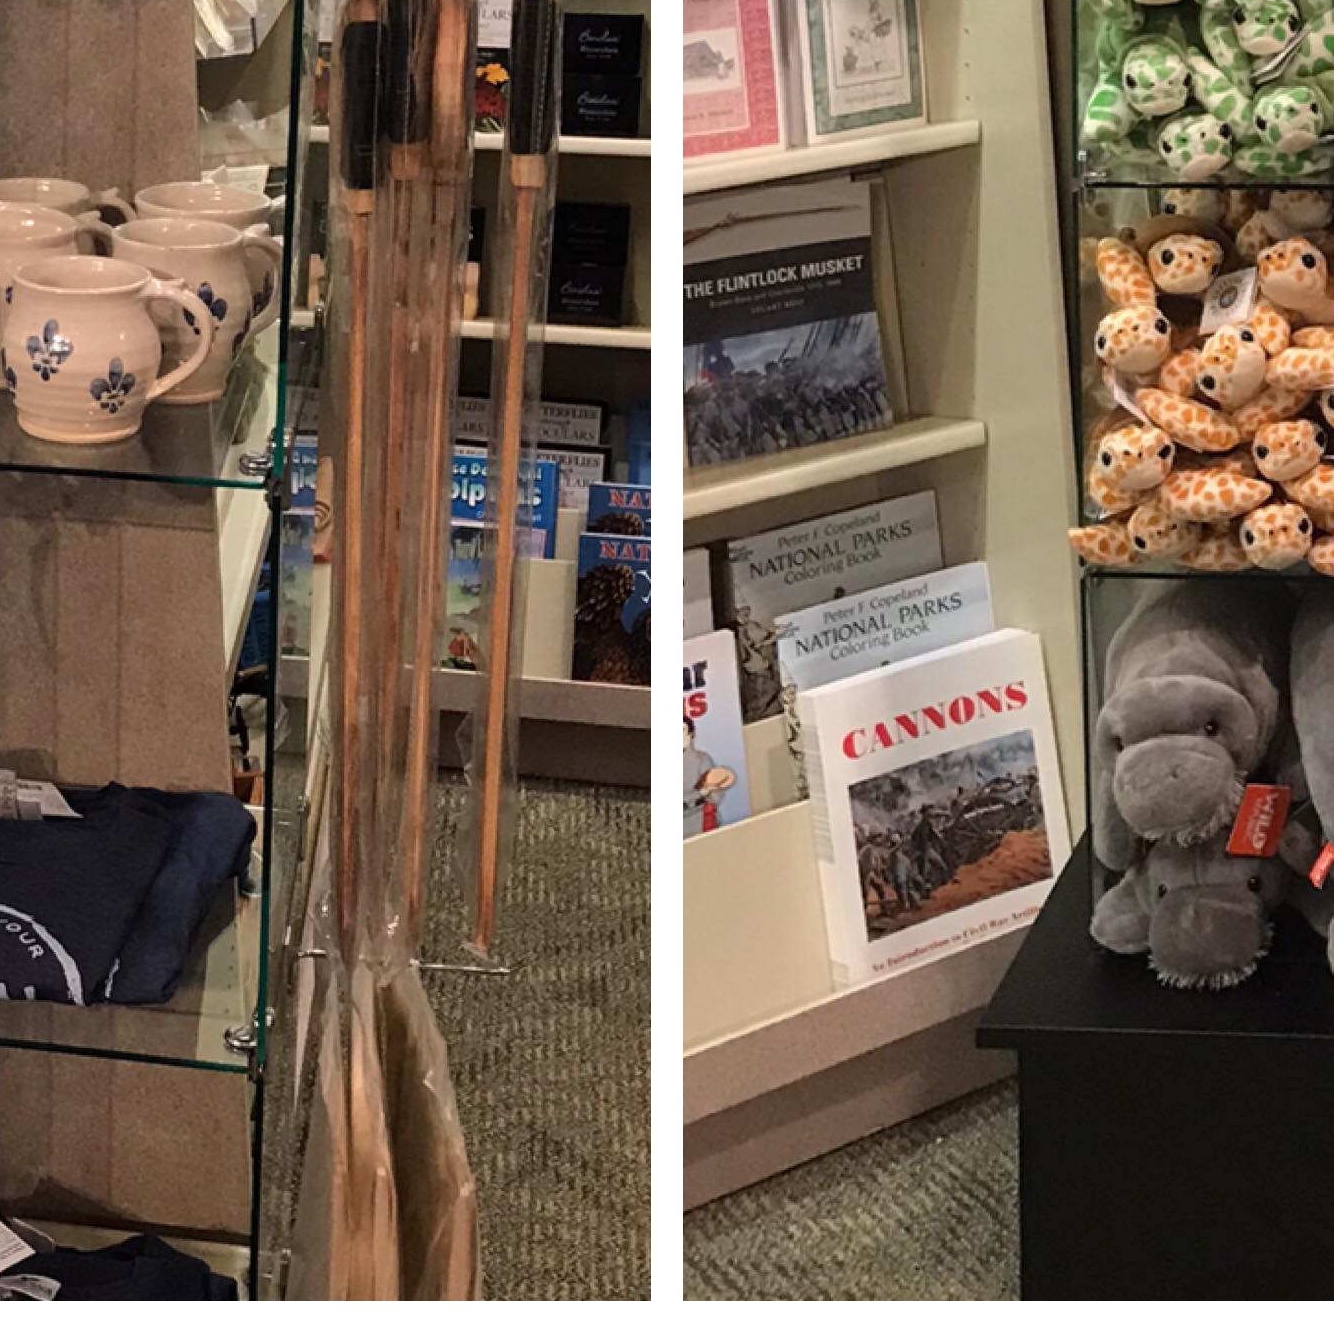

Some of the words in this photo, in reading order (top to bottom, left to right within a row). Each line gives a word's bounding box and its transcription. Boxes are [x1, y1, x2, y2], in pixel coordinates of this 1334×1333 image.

[685, 282, 714, 300] THE
[716, 266, 797, 294] FLINTLOCK
[802, 255, 863, 278] MUSKET
[749, 541, 845, 580] NATIONAL
[853, 520, 912, 549] PARKS
[794, 614, 892, 656] NATIONAL
[898, 592, 963, 622] PARKS
[829, 636, 884, 662] Coloring
[888, 620, 931, 645] Book
[842, 681, 1029, 761] CANNONS
